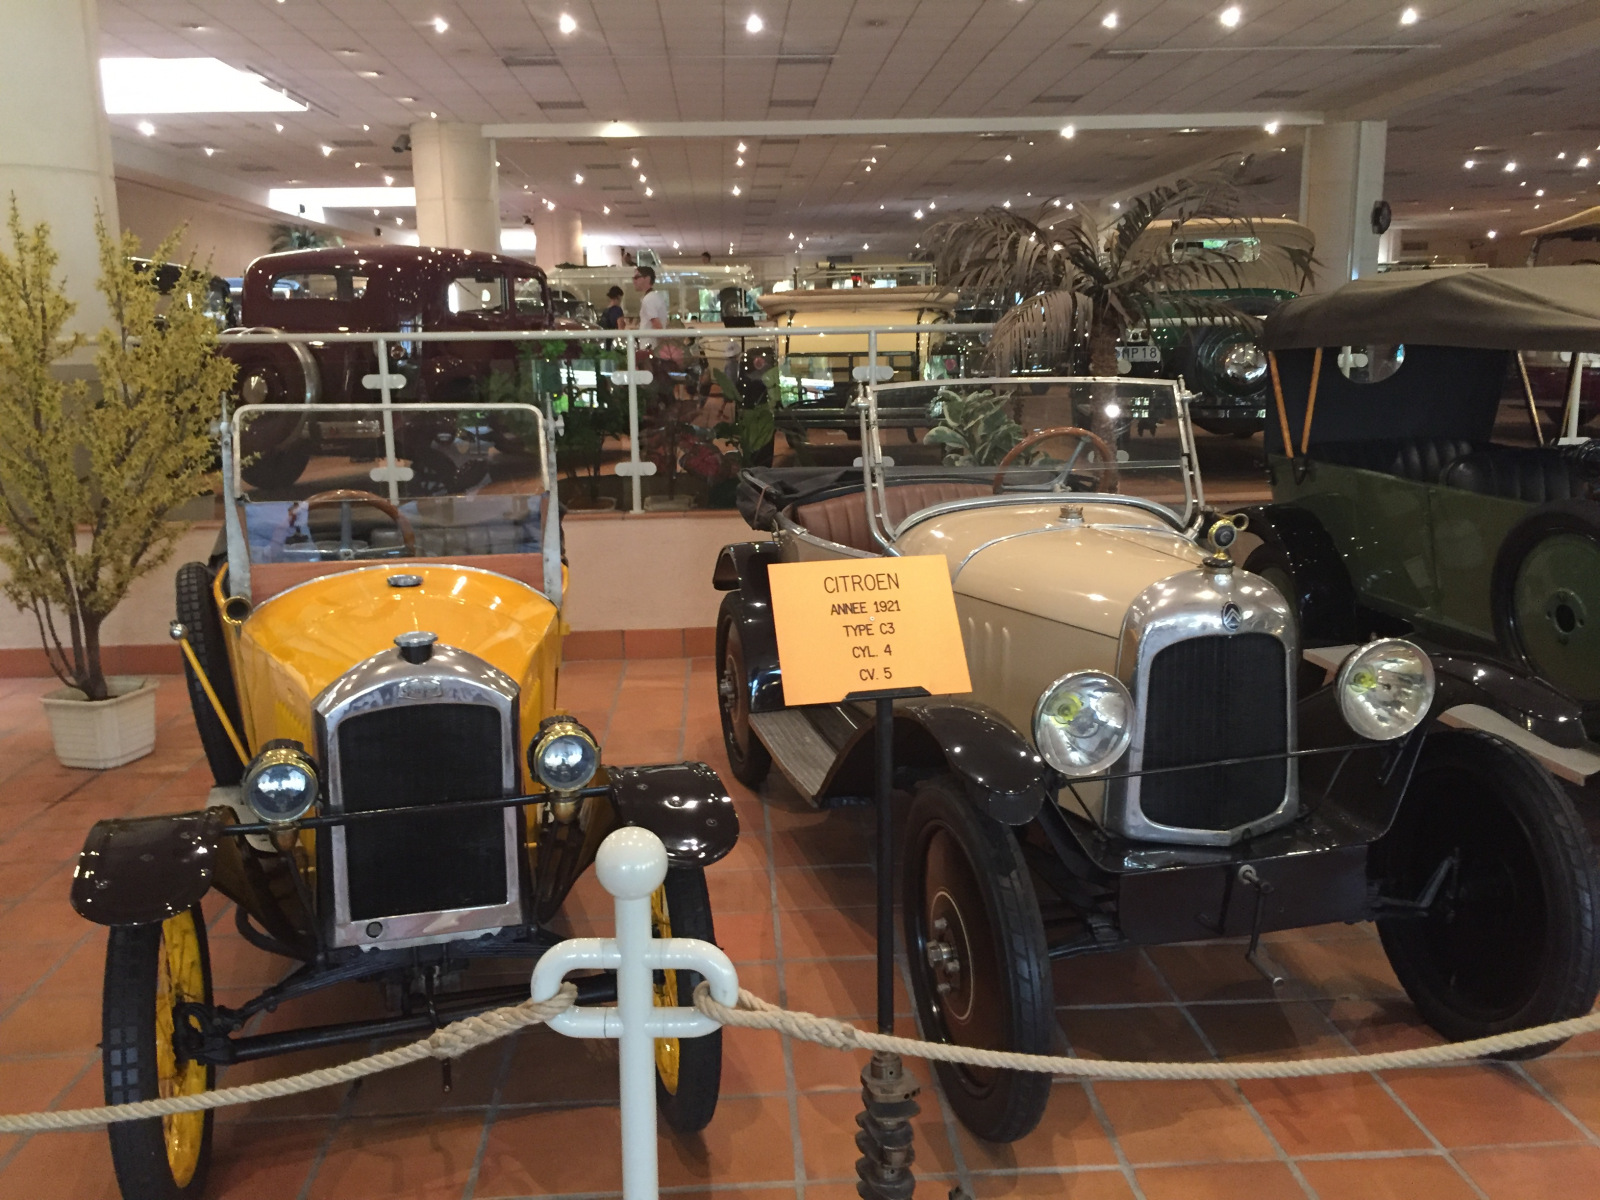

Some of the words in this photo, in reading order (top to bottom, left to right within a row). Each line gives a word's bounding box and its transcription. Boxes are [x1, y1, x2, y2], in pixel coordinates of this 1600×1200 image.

[823, 573, 900, 593] CITROEN
[830, 602, 868, 615] ANNEE
[873, 600, 901, 613] 1921
[843, 624, 874, 637] TYPE
[879, 622, 895, 635] C3
[852, 646, 878, 658] CYL.
[884, 644, 892, 656] 4
[859, 668, 879, 681] CV.
[884, 667, 892, 680] 5
